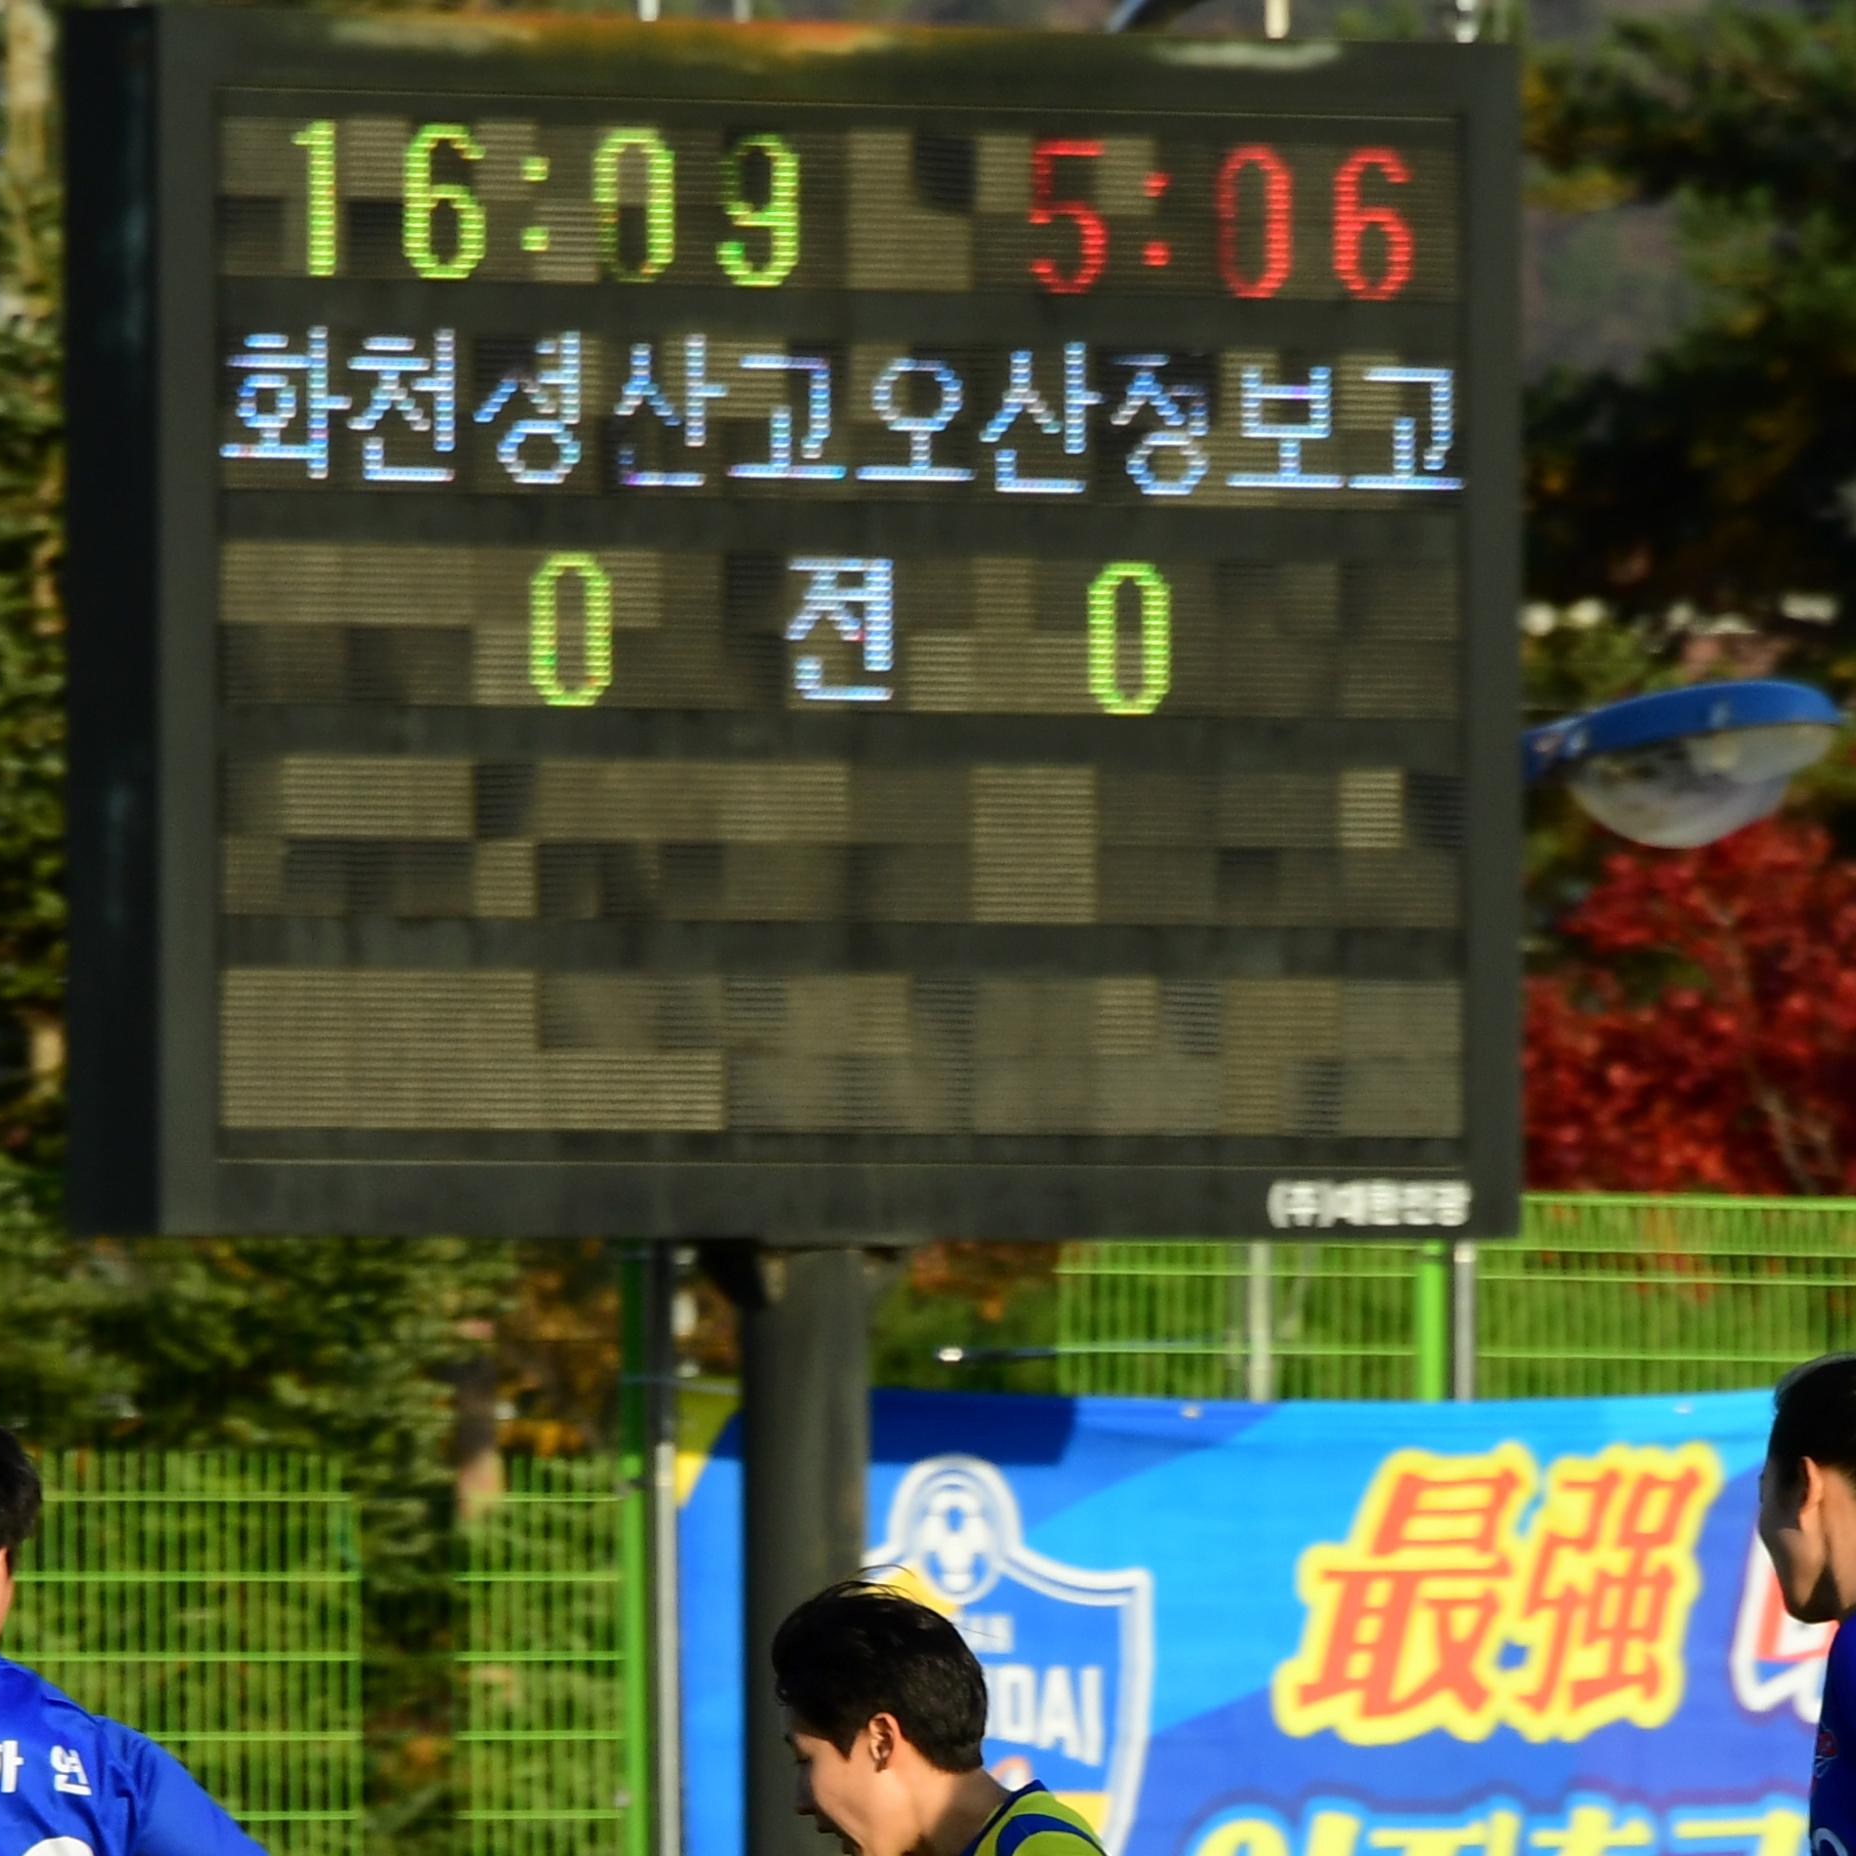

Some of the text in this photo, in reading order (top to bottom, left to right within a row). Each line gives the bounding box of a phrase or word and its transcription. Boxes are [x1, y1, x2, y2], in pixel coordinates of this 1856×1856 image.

[292, 120, 1413, 300] 16:09 5:06
[529, 552, 1170, 715] 0 전 0
[1282, 1450, 1714, 1734] 最強
